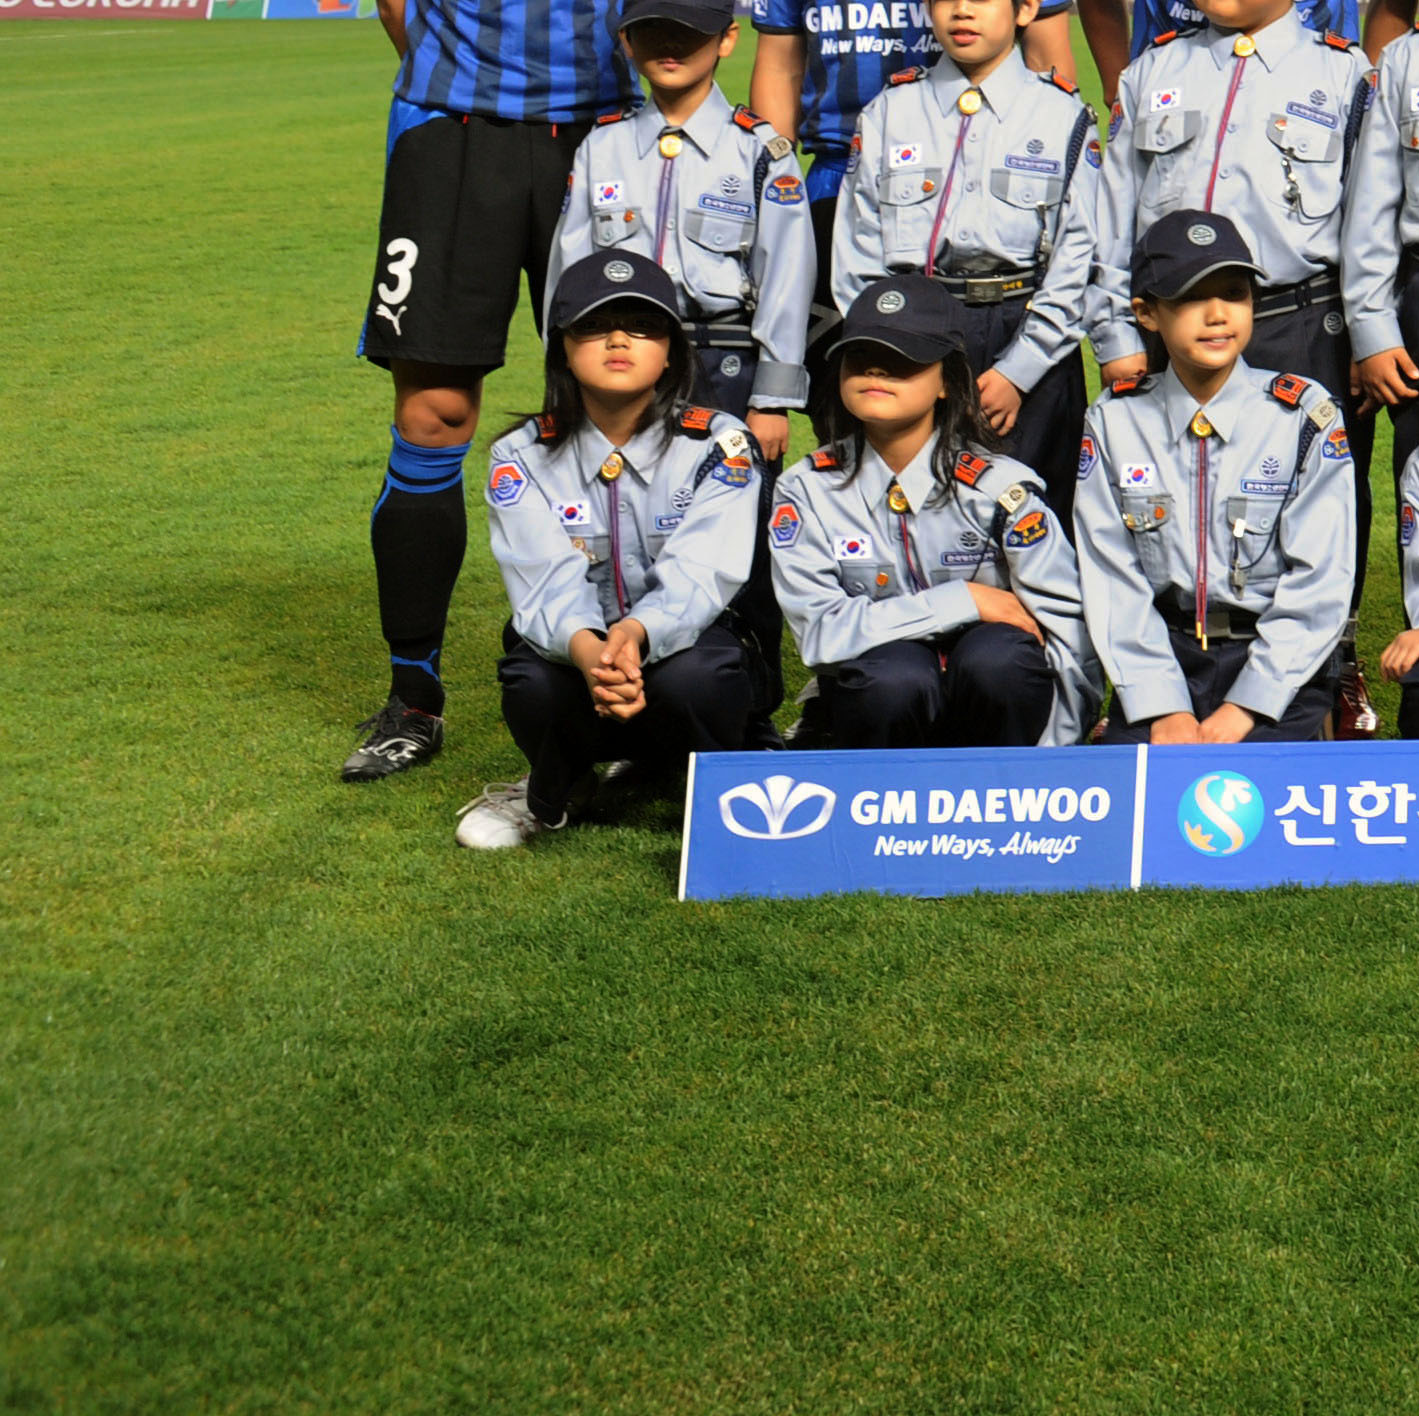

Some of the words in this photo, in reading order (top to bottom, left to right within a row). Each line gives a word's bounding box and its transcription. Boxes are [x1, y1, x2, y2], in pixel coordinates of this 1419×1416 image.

[806, 7, 843, 33] GM
[848, 3, 932, 31] DAEW
[821, 39, 850, 54] New
[855, 37, 907, 56] Ways,
[378, 238, 420, 306] 3
[851, 790, 917, 825] GM
[928, 786, 1111, 824] DAEWOO
[874, 835, 928, 856] New
[931, 834, 995, 860] Ways,
[999, 832, 1081, 864] Always
